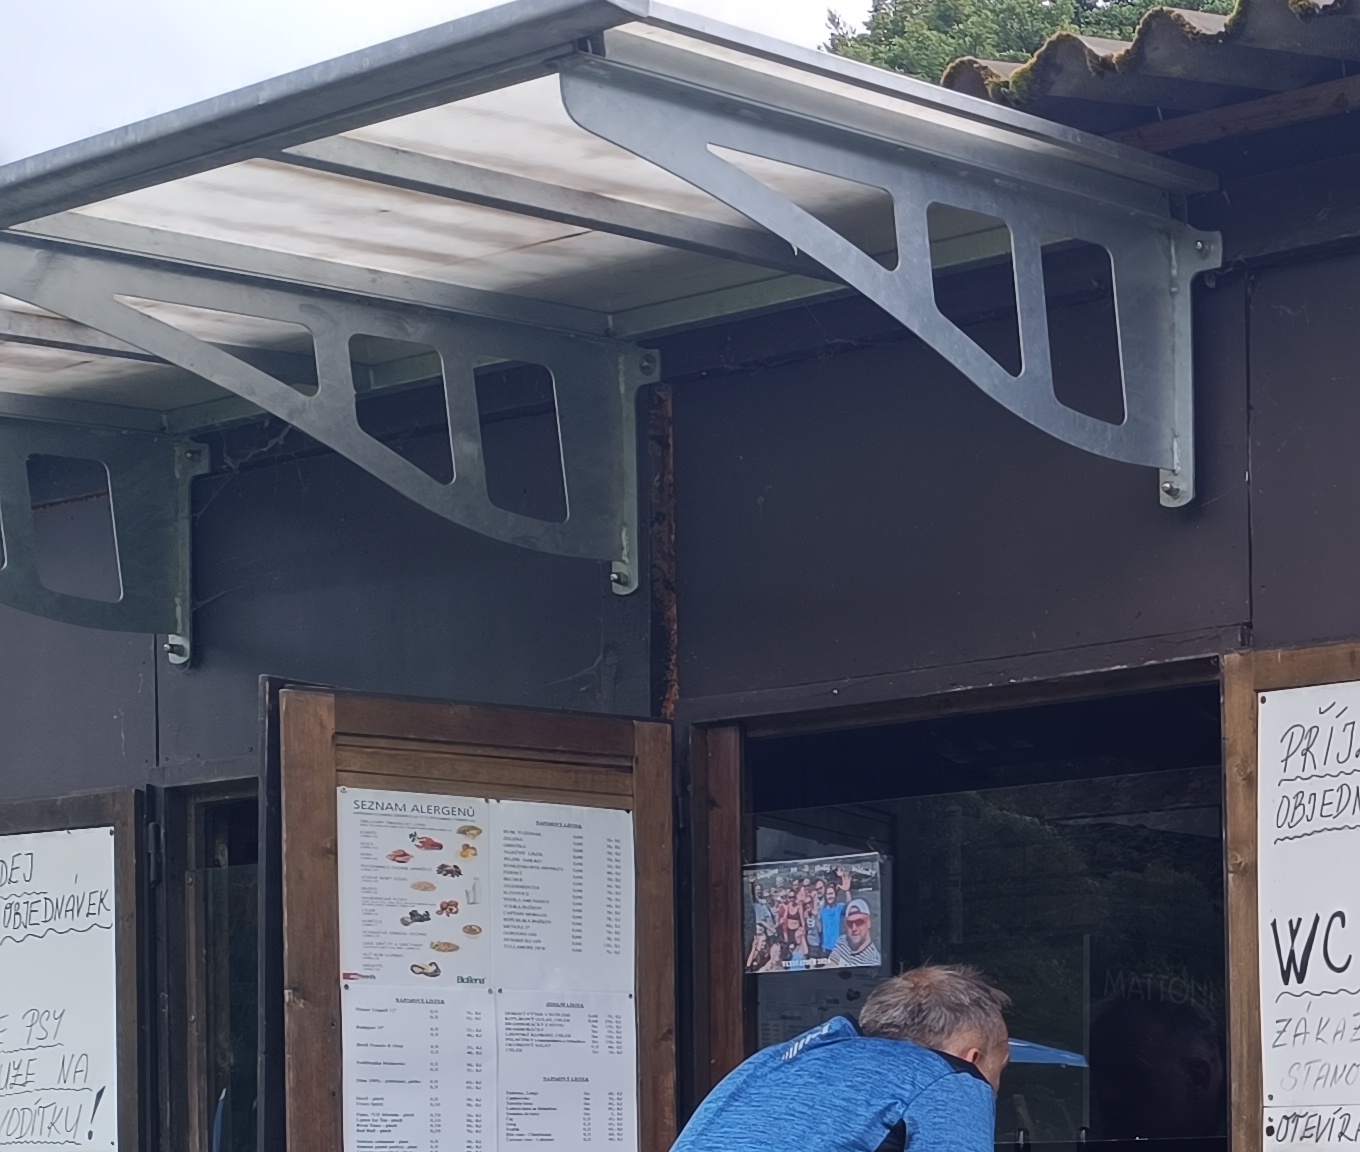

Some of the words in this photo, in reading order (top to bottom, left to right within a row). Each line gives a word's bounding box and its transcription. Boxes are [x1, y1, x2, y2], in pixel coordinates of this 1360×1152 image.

[353, 799, 407, 813] SEZNAM
[411, 803, 476, 818] ALERGENŮ
[3, 872, 111, 930] OBJEDNÁVEK
[1270, 910, 1353, 986] WC
[21, 1008, 66, 1046] PSY
[57, 1053, 89, 1085] NA
